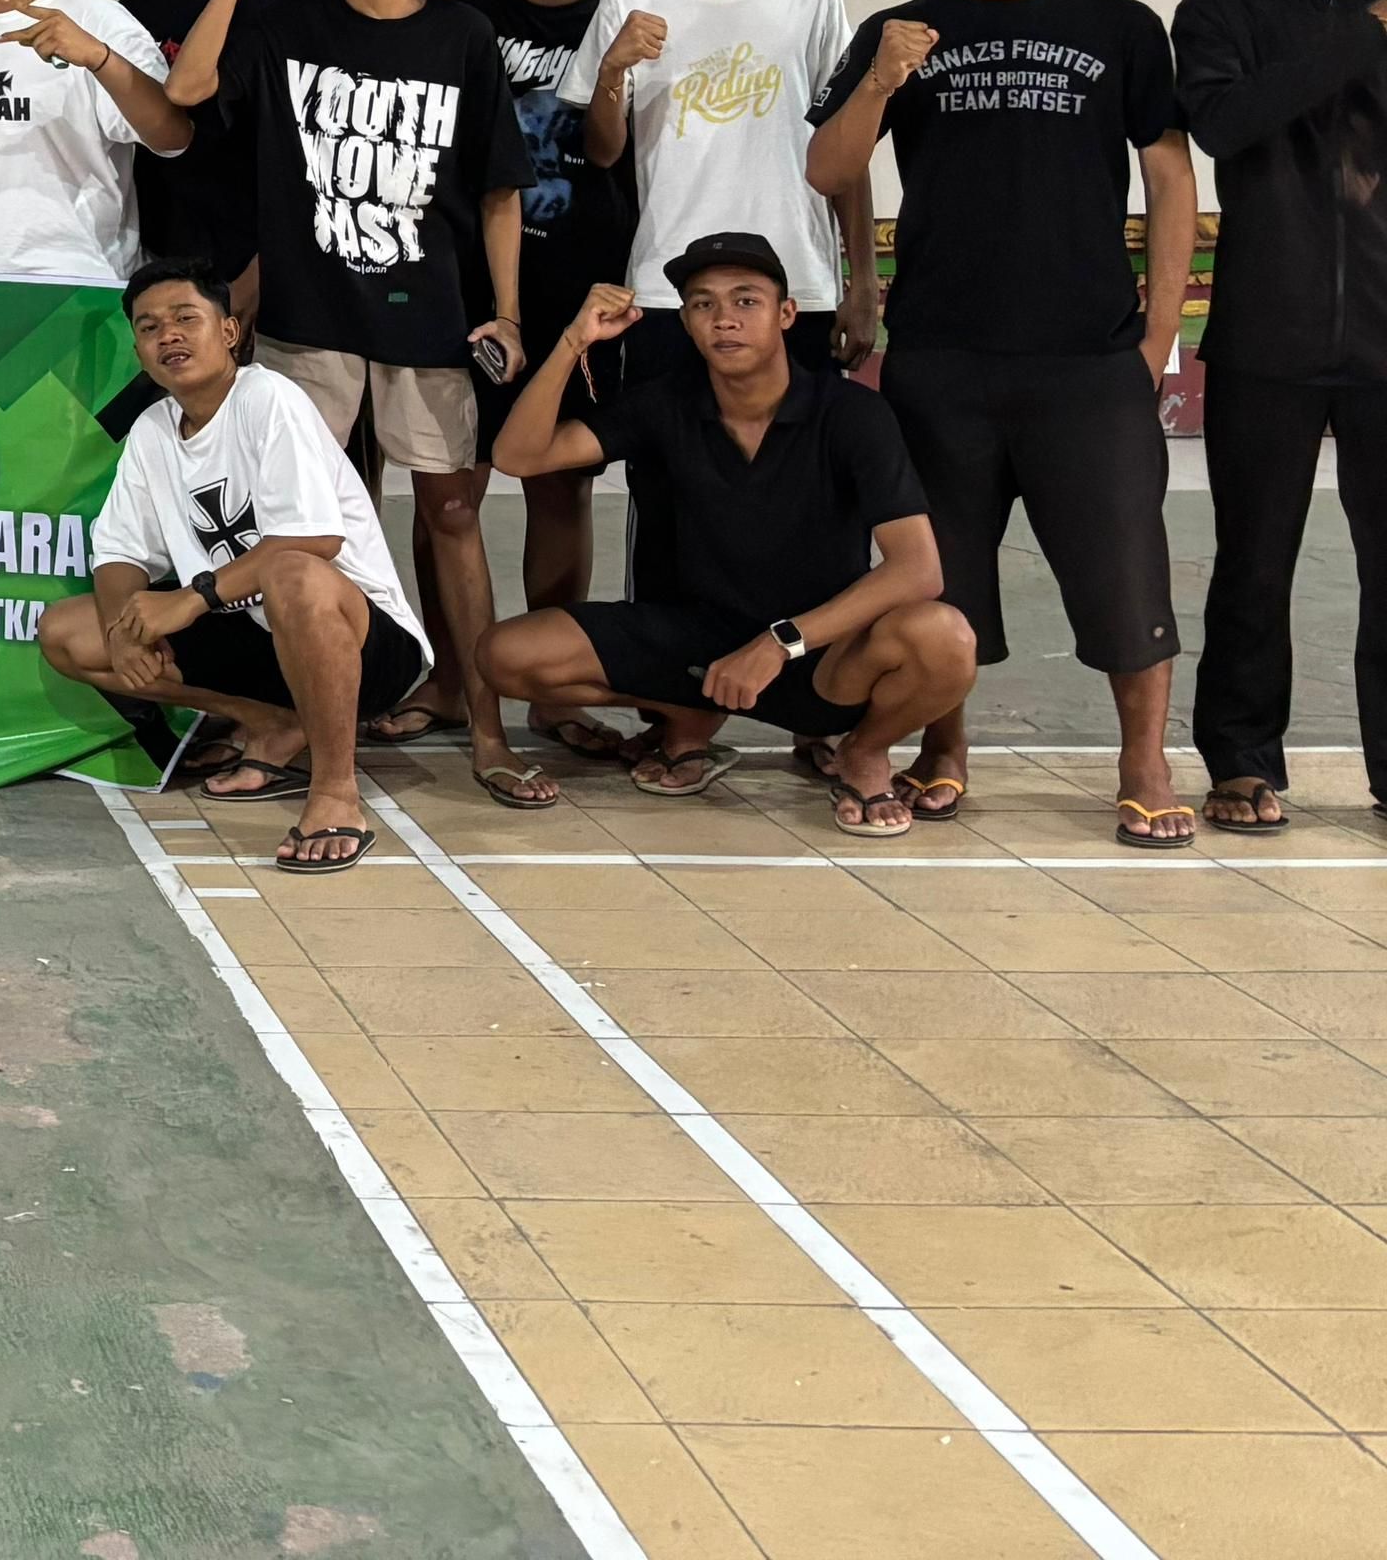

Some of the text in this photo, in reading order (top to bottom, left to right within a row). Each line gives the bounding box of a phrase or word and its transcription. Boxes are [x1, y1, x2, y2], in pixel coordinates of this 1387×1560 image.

[949, 71, 1069, 90] WITH BROTHER
[286, 57, 461, 148] YOUTH
[936, 89, 1087, 115] TEAM SATSET
